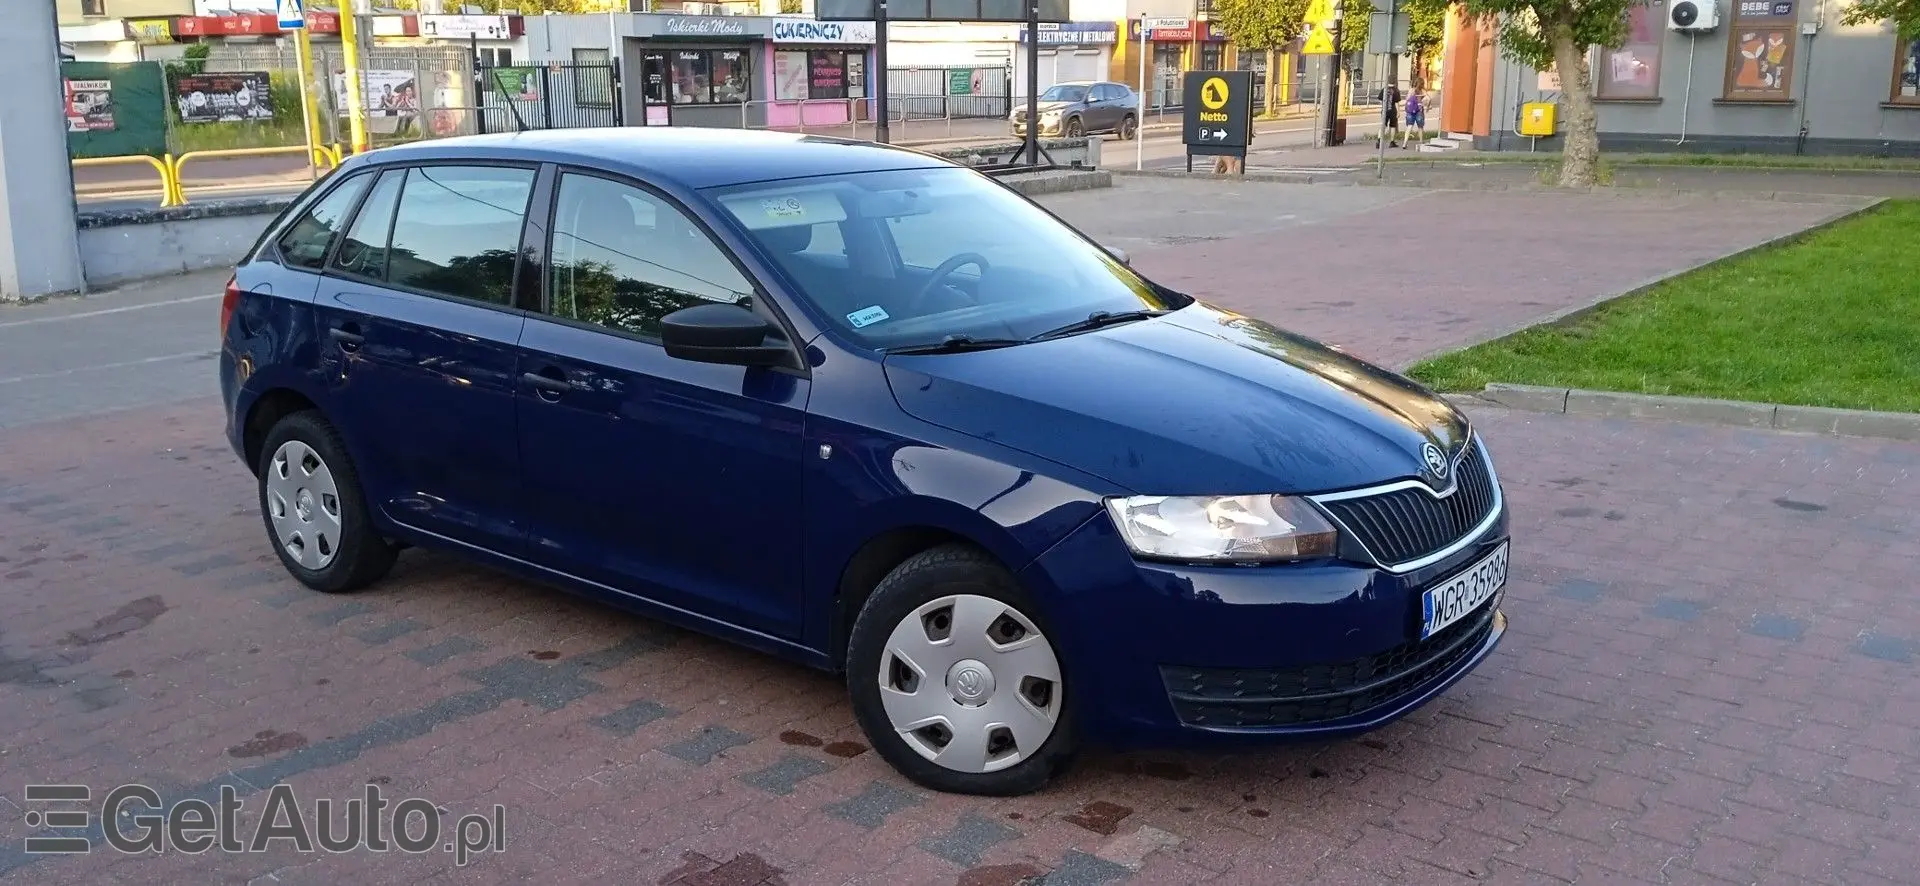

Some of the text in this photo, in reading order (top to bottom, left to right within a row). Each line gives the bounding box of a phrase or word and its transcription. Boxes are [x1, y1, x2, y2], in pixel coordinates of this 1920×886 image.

[1741, 2, 1770, 11] BEBE
[667, 18, 744, 35] Iskierki Mody
[774, 22, 845, 40] CUKIERNICZY
[1200, 112, 1228, 121] Netto
[1201, 129, 1208, 139] P
[1433, 548, 1507, 630] WGR 35986
